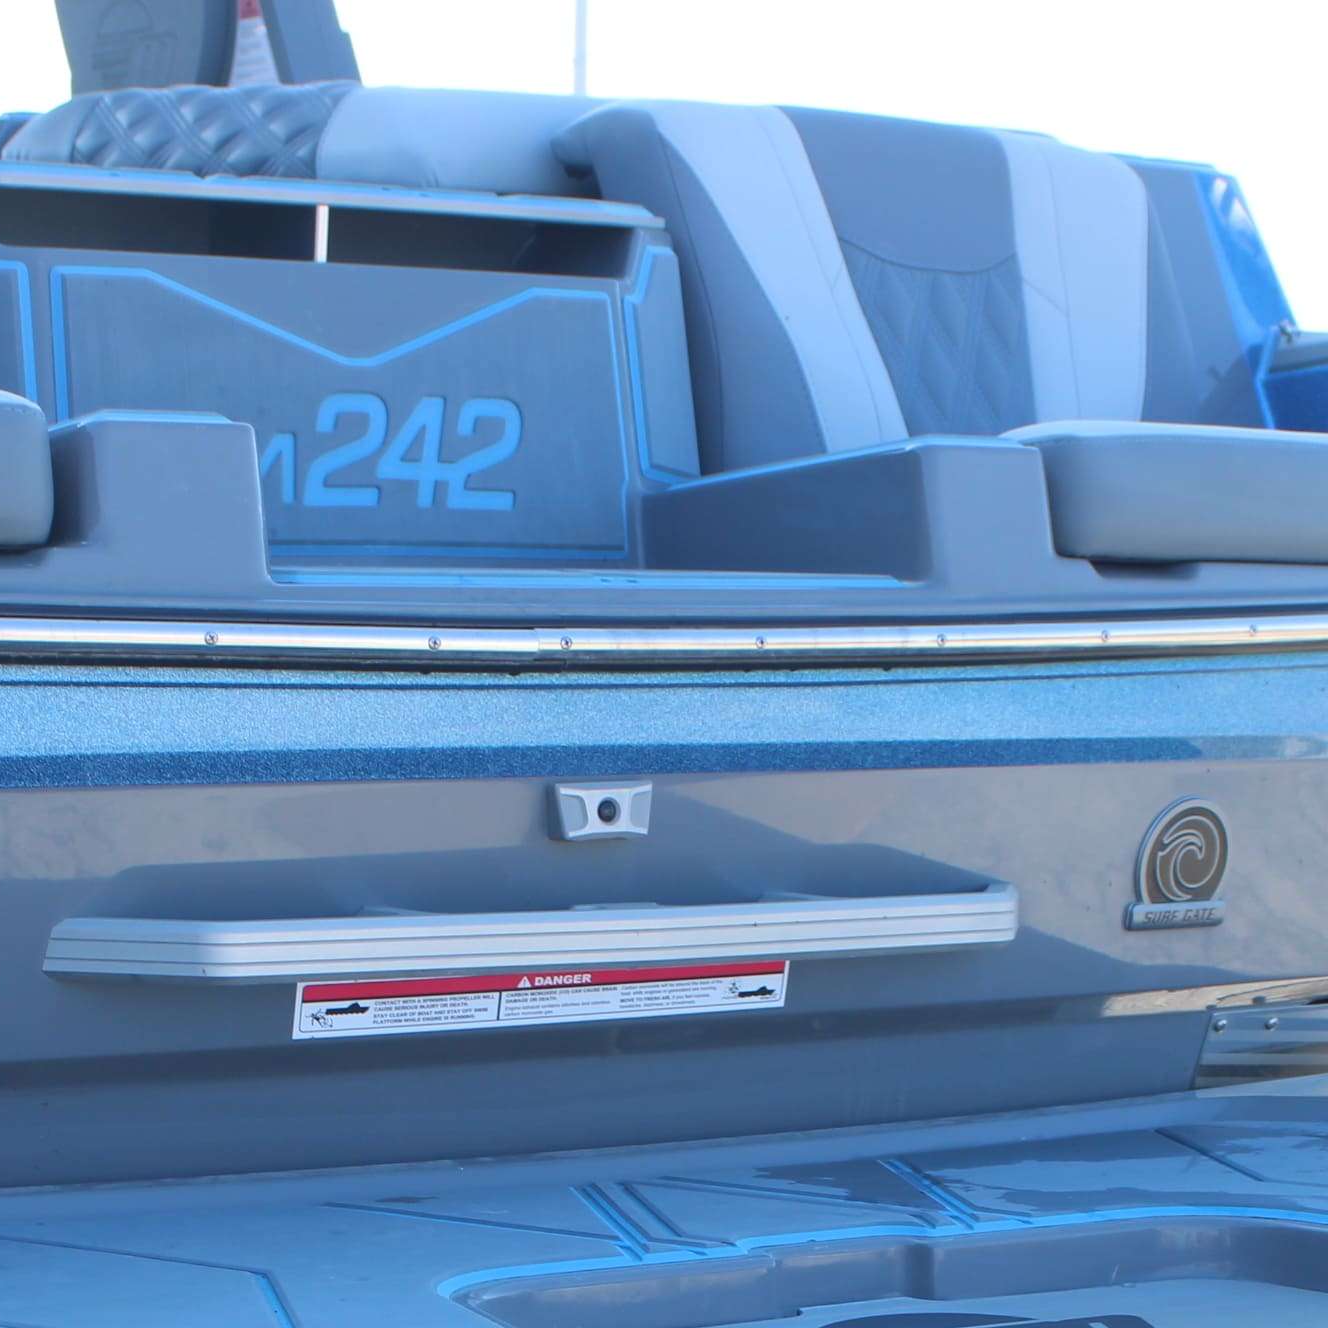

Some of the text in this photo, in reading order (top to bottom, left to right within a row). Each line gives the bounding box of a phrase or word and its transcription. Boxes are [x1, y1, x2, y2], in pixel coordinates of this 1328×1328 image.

[1144, 907, 1217, 925] SURF GATE
[534, 973, 592, 986] DANGER
